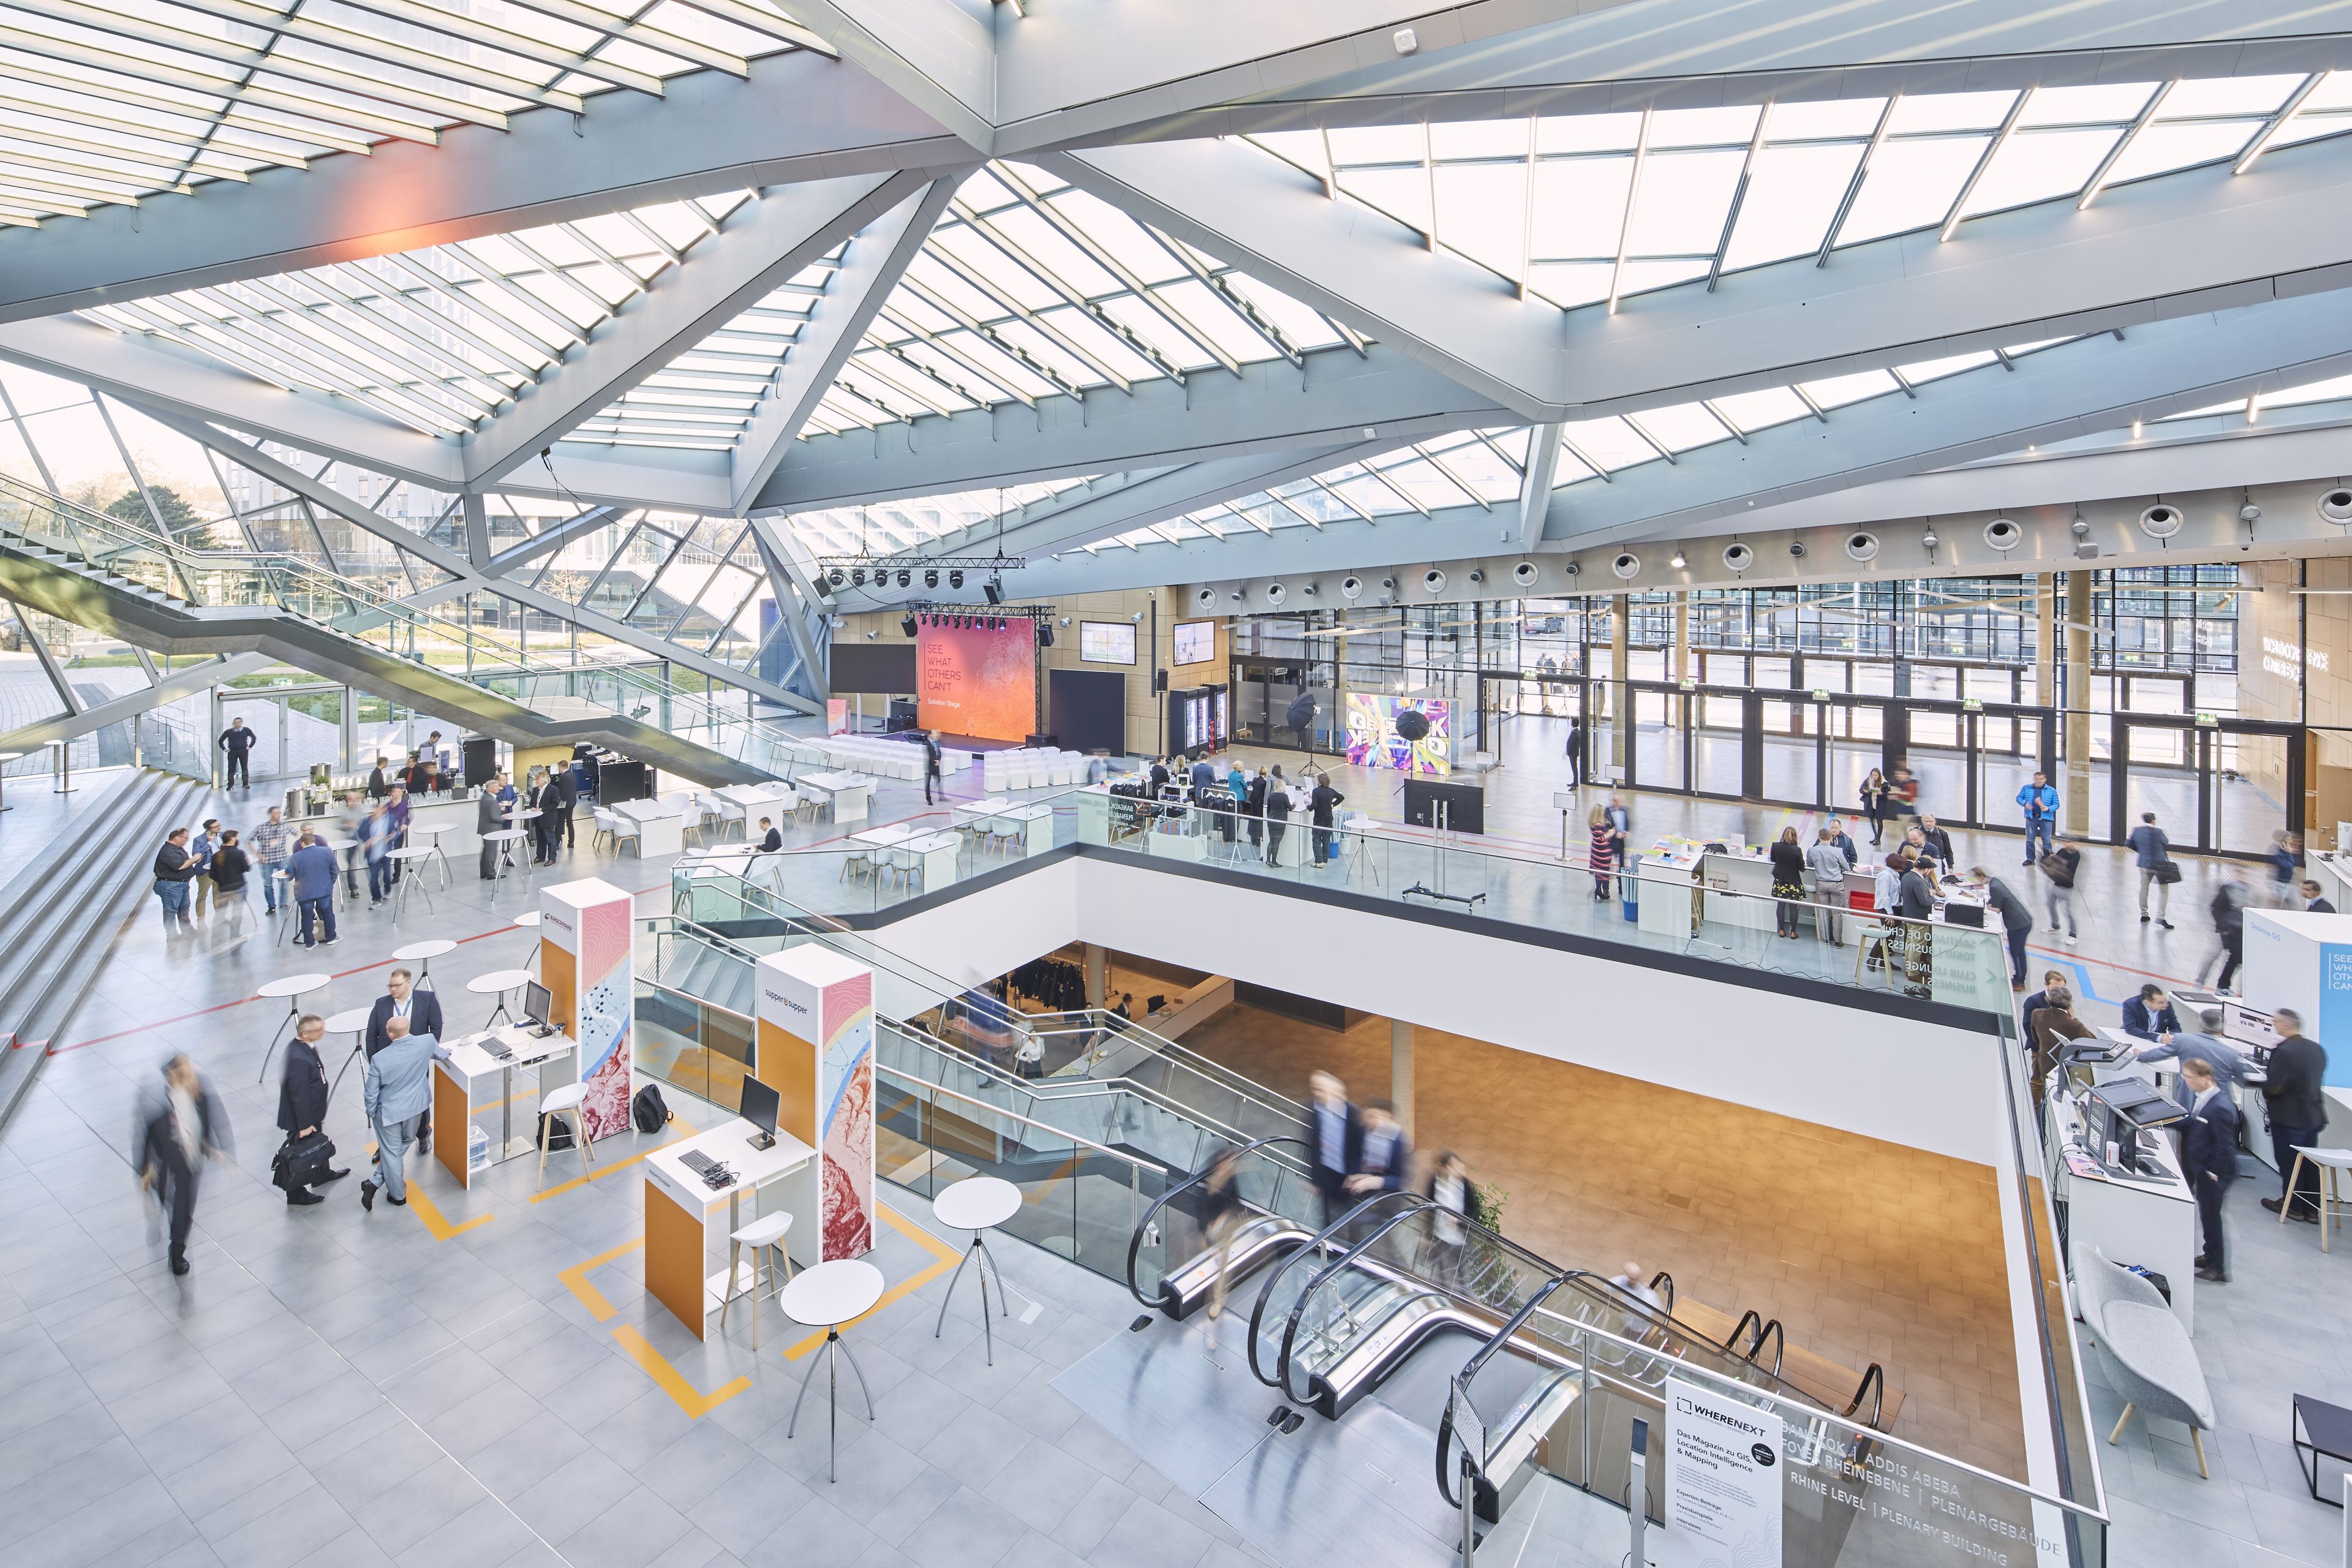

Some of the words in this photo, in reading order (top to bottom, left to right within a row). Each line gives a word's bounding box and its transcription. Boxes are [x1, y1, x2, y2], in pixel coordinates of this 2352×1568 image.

[927, 644, 943, 654] SEE
[927, 657, 952, 666] WHAT
[927, 668, 961, 680] OTHERS
[927, 680, 952, 692] CAN'T
[947, 700, 960, 709] Stage
[2251, 922, 2271, 937] Desktop
[2272, 932, 2281, 941] GIS
[766, 989, 783, 1003] supper
[788, 1000, 807, 1015] supper
[1694, 1414, 1723, 1427] DEUTSCHLAND
[1727, 1425, 1746, 1435] SCHWEIZ
[1695, 1404, 1766, 1437] WHERENEXT
[1677, 1429, 1691, 1439] Das
[1693, 1435, 1724, 1452] Magazin
[1737, 1453, 1752, 1464] GIS,
[1677, 1438, 1708, 1455] Location
[1710, 1451, 1753, 1472] Intelligence
[1685, 1450, 1718, 1469] Mapping
[1782, 1421, 1846, 1456] BANGKOK
[1865, 1453, 1908, 1478] ADDIS
[1912, 1471, 1960, 1499] ABEBA
[1676, 1488, 1722, 1510] Experten-Beiträge
[1782, 1438, 1820, 1463] FOYER
[1825, 1455, 1910, 1498] RHEINEBENE
[1932, 1495, 2061, 1556] PLENARGEBÄUDE
[1676, 1502, 1713, 1521] Praxisbeispiele
[1791, 1471, 1828, 1495] RHINE
[1831, 1487, 1866, 1510] LEVEL
[1881, 1507, 1939, 1539] PLENARY
[1943, 1531, 2008, 1566] BUILDING
[1676, 1516, 1702, 1531] Interviews
